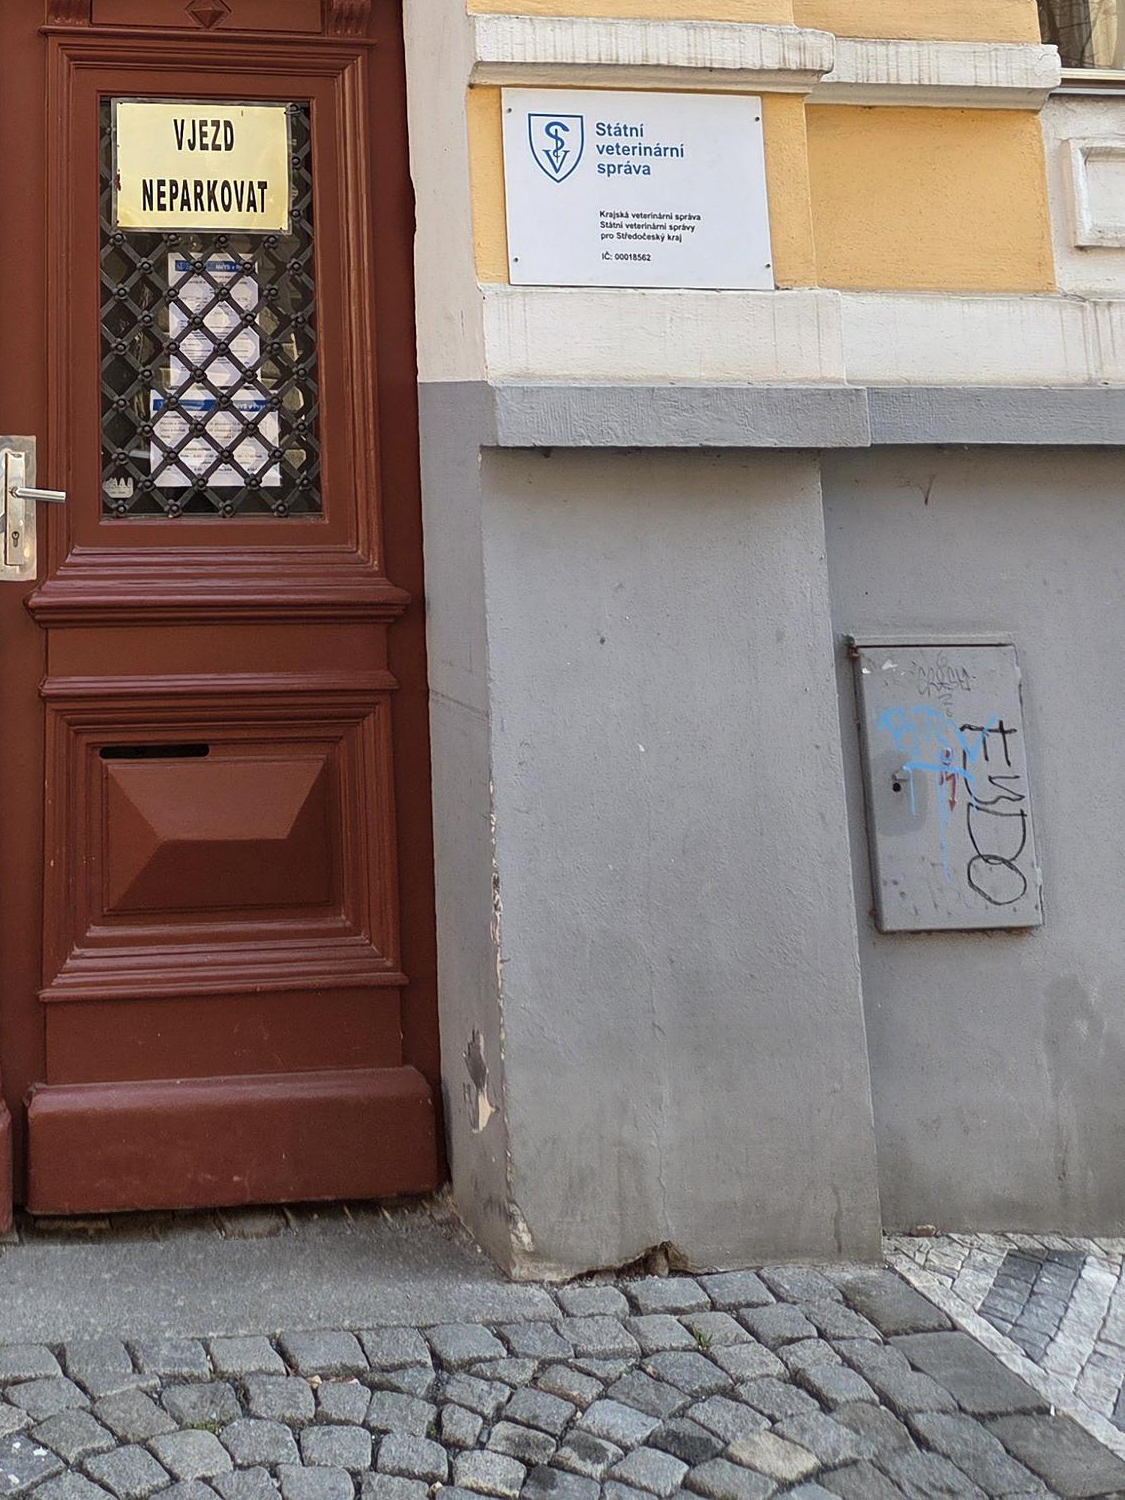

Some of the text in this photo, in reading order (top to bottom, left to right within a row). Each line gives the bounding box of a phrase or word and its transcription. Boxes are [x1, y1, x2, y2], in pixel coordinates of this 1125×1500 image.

[173, 118, 235, 152] VJEZD
[595, 122, 644, 137] Státní
[596, 142, 684, 158] veterinární
[597, 161, 651, 177] správa
[141, 179, 268, 213] NEPARKOVAT
[599, 210, 701, 222] Krajská veterinární správa
[600, 221, 695, 233] Státní veterinární správy
[600, 231, 682, 243] pro Středočeský kraj
[601, 251, 651, 261] IČ: 00018562
